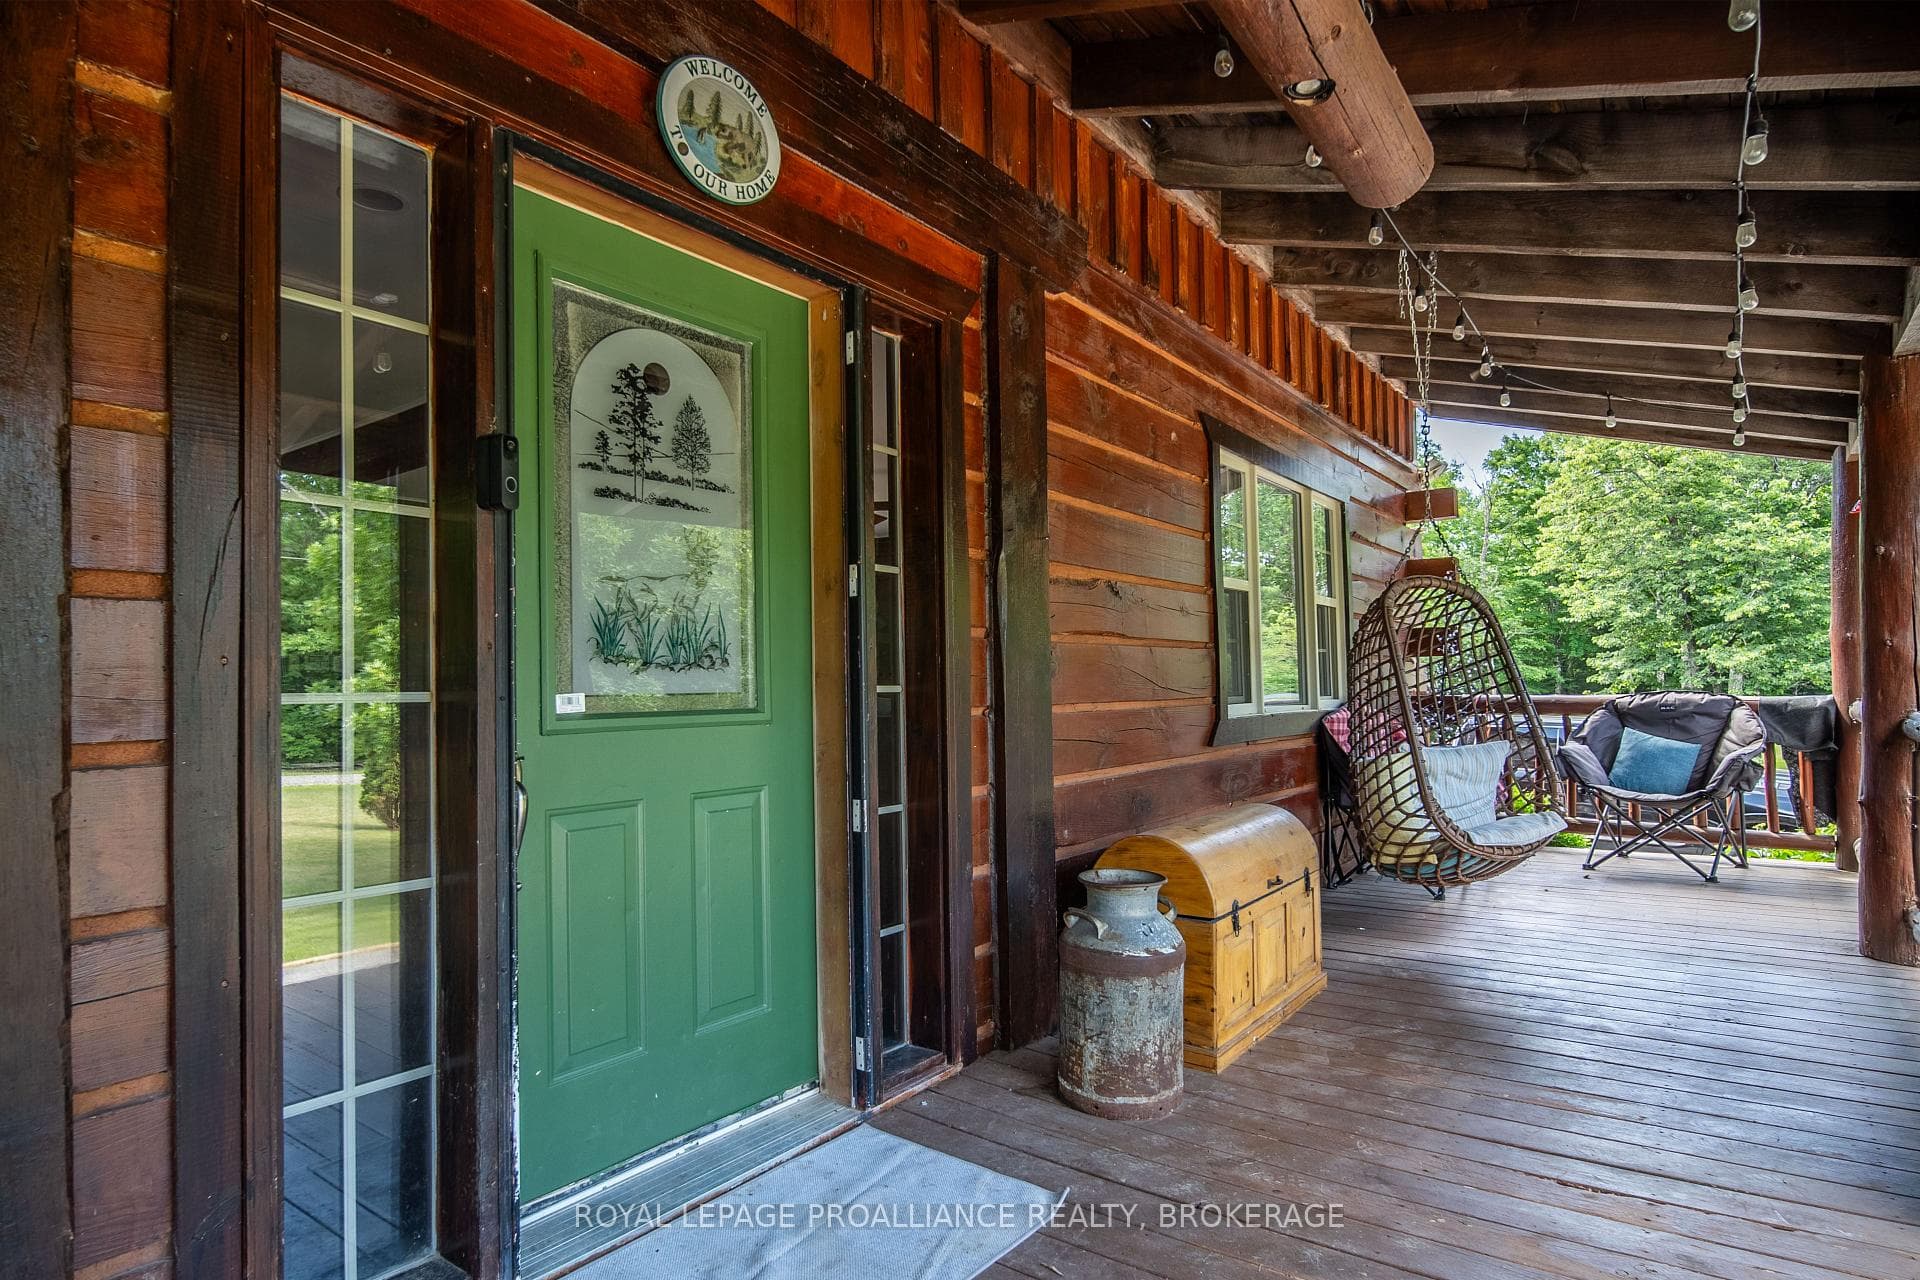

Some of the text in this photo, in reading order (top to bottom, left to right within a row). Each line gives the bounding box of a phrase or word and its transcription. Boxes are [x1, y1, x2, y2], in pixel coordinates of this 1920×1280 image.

[684, 59, 768, 117] WELCOME
[693, 163, 728, 196] OUR
[735, 169, 776, 200] HOME
